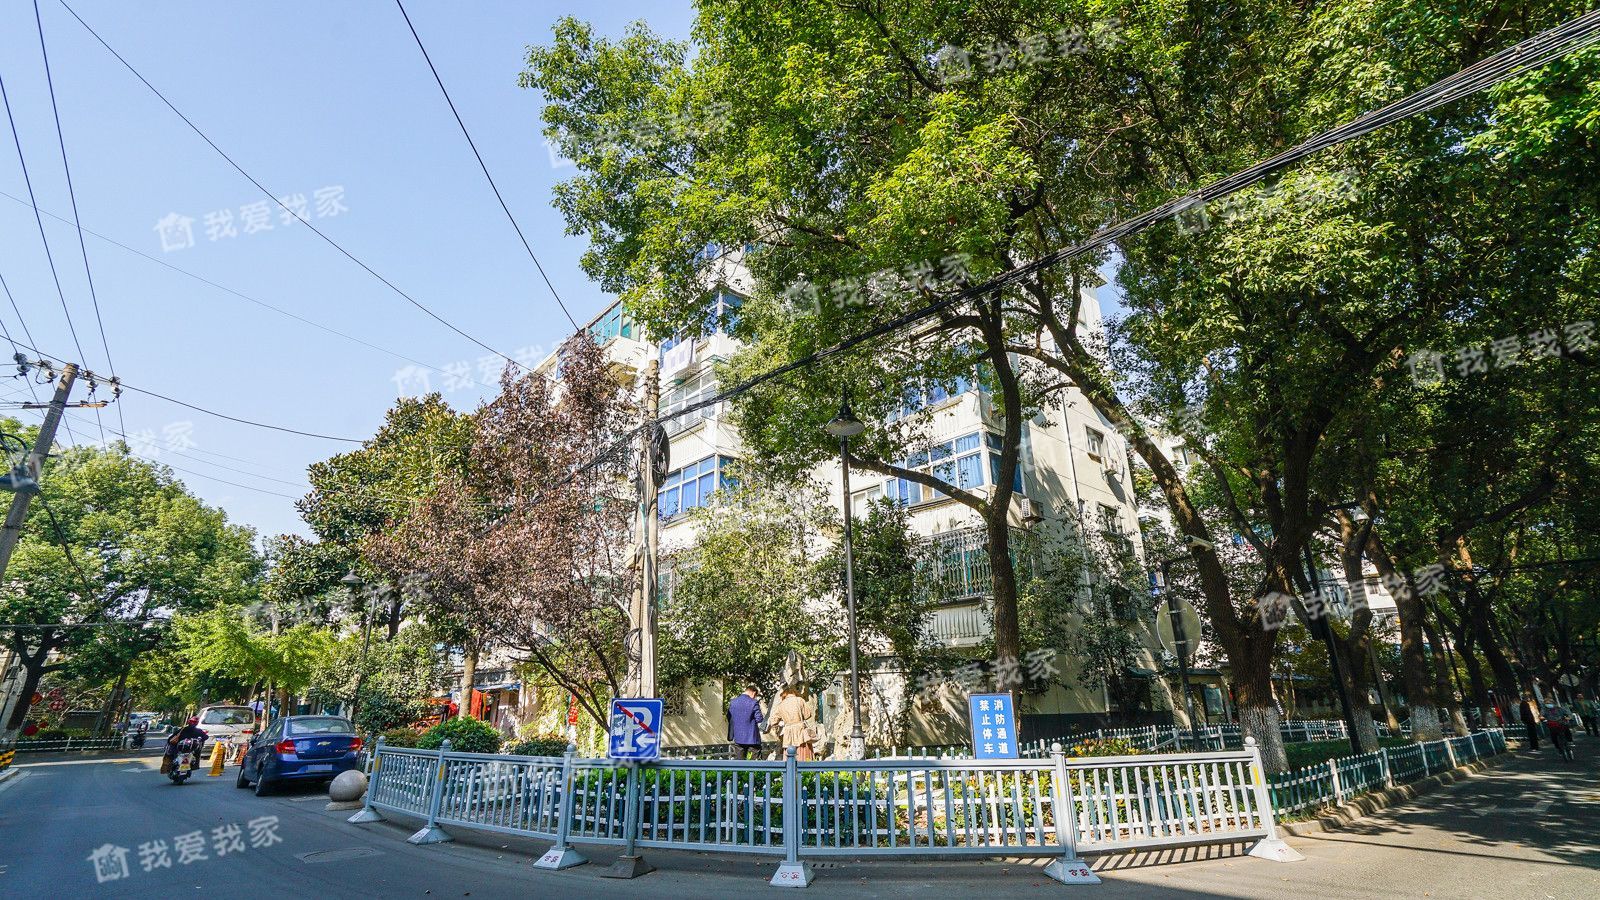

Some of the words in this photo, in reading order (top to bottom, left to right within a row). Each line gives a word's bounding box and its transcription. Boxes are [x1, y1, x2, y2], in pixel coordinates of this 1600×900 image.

[979, 699, 995, 754] 禁止停车
[994, 699, 1009, 754] 消防通道
